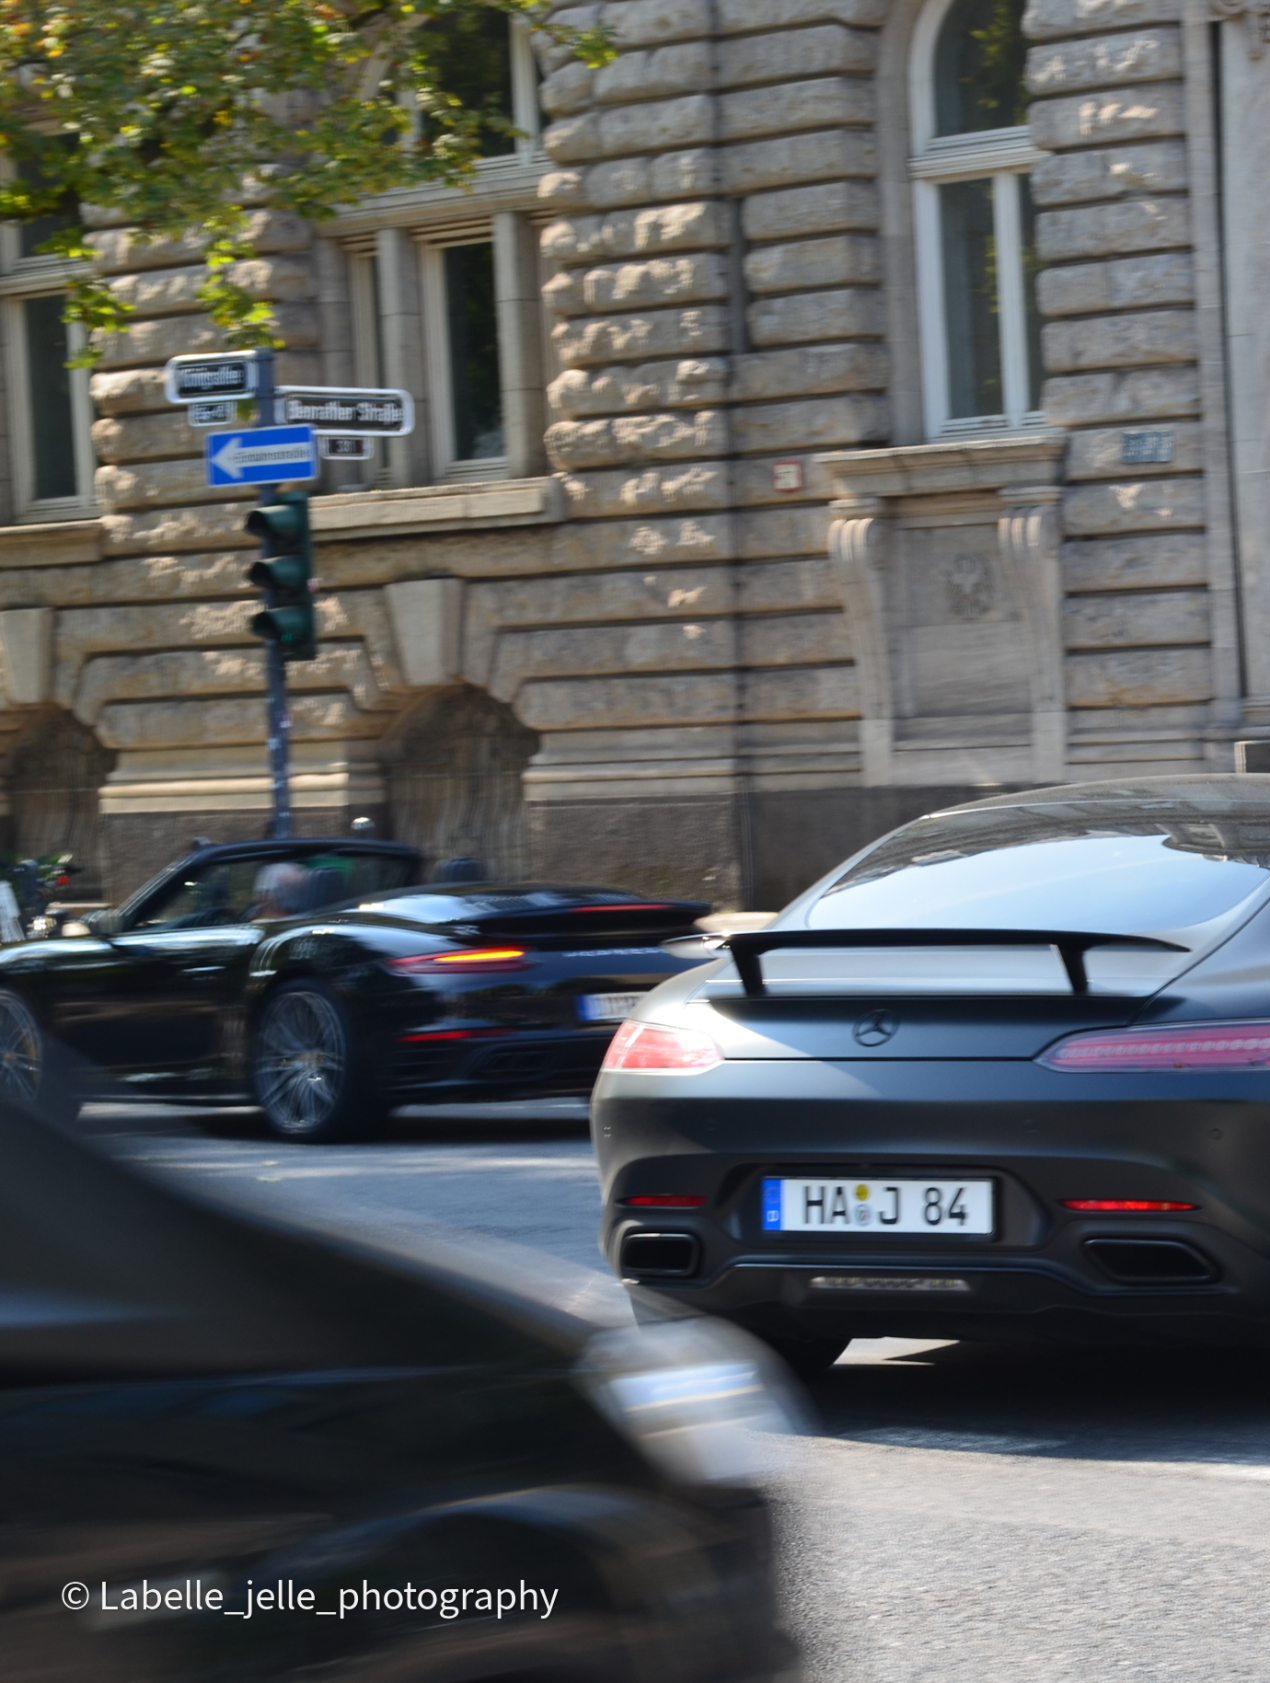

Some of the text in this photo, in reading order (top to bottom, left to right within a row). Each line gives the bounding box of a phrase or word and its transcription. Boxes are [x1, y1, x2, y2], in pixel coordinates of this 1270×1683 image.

[803, 1186, 849, 1224] HA
[878, 1187, 900, 1226] J
[923, 1187, 968, 1226] 84
